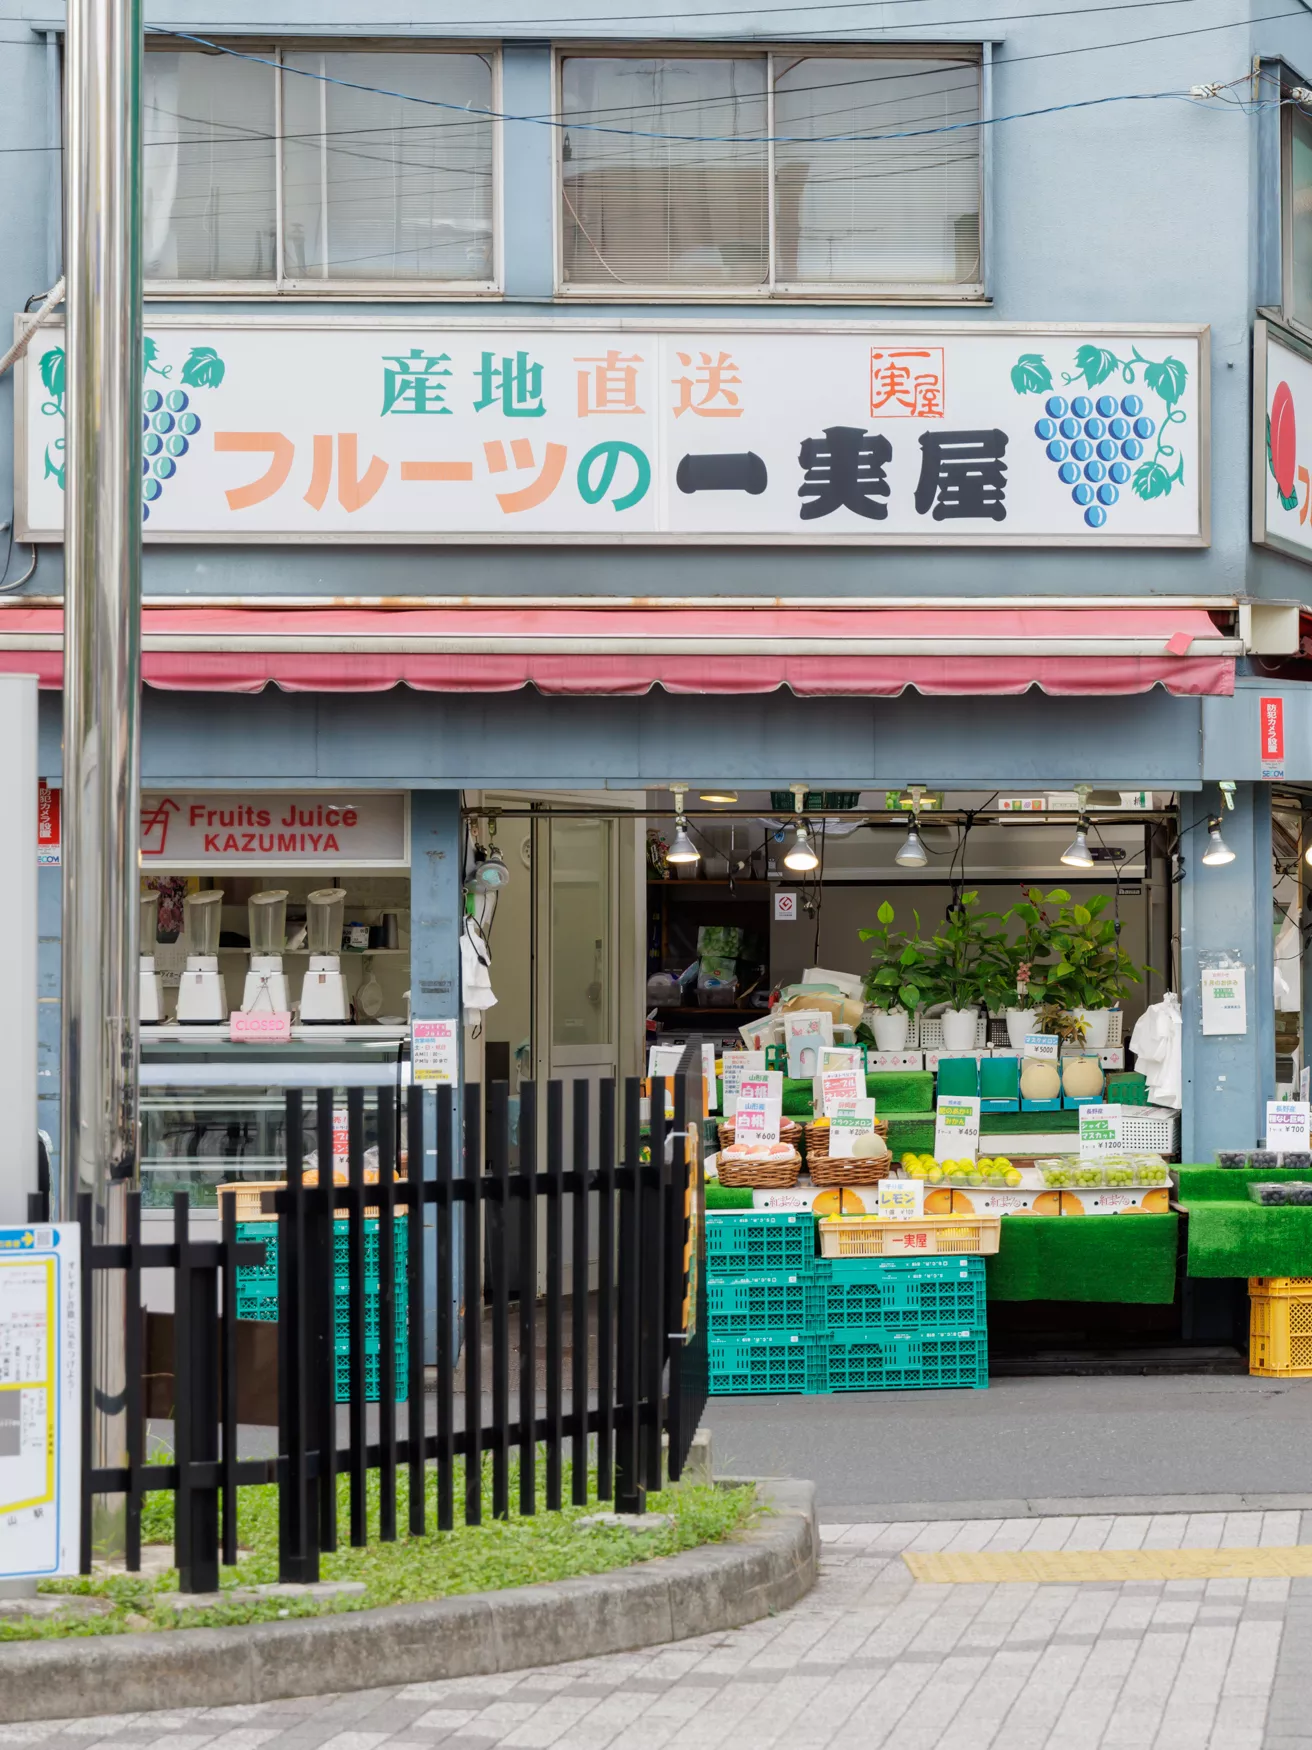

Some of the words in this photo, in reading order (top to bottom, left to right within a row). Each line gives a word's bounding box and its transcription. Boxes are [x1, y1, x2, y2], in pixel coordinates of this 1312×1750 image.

[380, 348, 744, 418] 産地直送
[213, 425, 1009, 521] フルーツの一実屋
[1267, 704, 1278, 753] 防犯カメラ設置
[1262, 770, 1284, 778] SECOM
[39, 788, 52, 838] 防犯カメラ設置
[189, 804, 271, 827] Fruits
[282, 803, 358, 827] Juice
[204, 833, 340, 852] KAZUMIYA
[235, 1020, 285, 1031] CLOSED
[825, 1079, 856, 1088] ネーブル
[1276, 1105, 1296, 1113] 長野産
[738, 1114, 764, 1128] 白桃
[831, 1118, 872, 1126] クラウンメロン
[1081, 1121, 1108, 1129] シャイン
[756, 1132, 776, 1140] ¥600
[958, 1128, 978, 1136] ¥450
[1081, 1131, 1115, 1139] マスカット
[1098, 1141, 1122, 1149] ¥1200
[881, 1193, 915, 1204] レモン
[892, 1233, 927, 1249] 一実屋
